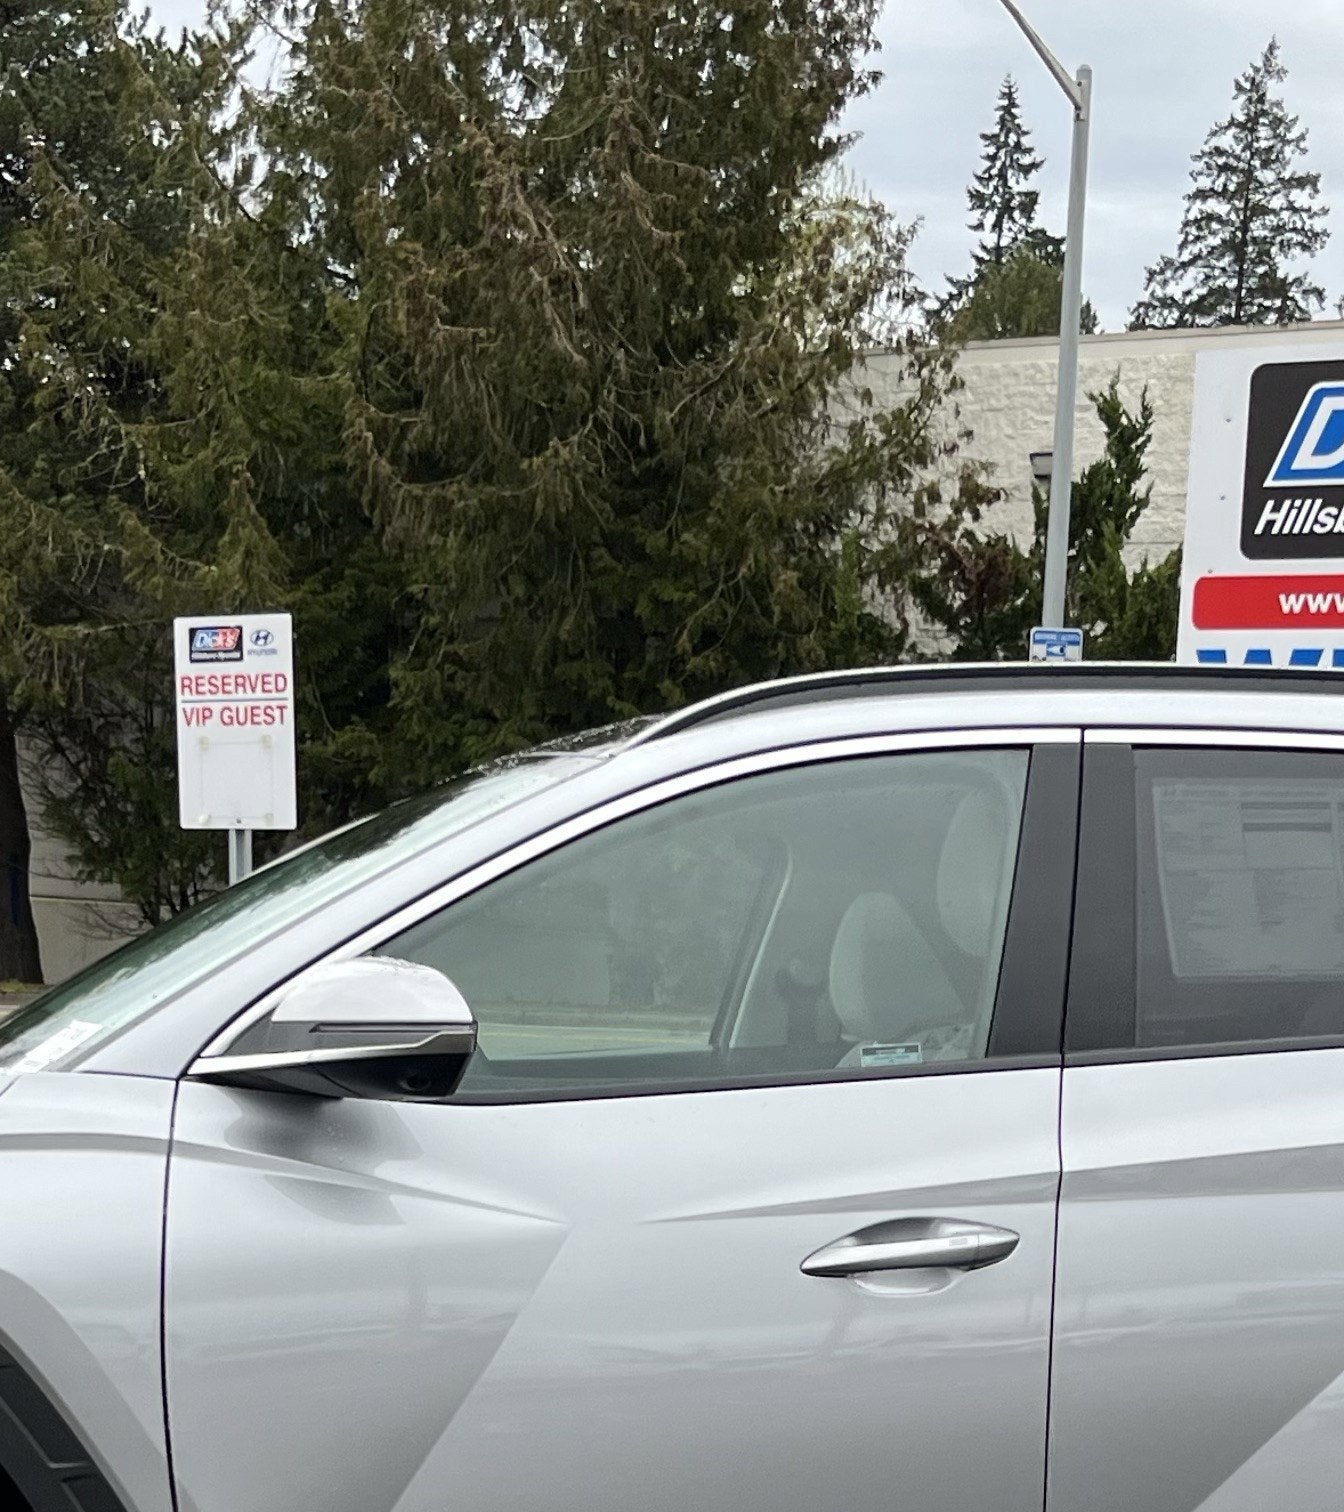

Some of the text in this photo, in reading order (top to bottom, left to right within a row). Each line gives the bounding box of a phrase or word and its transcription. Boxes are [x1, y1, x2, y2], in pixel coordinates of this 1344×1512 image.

[180, 673, 288, 696] RESERVED
[182, 705, 288, 727] VIP GUEST
